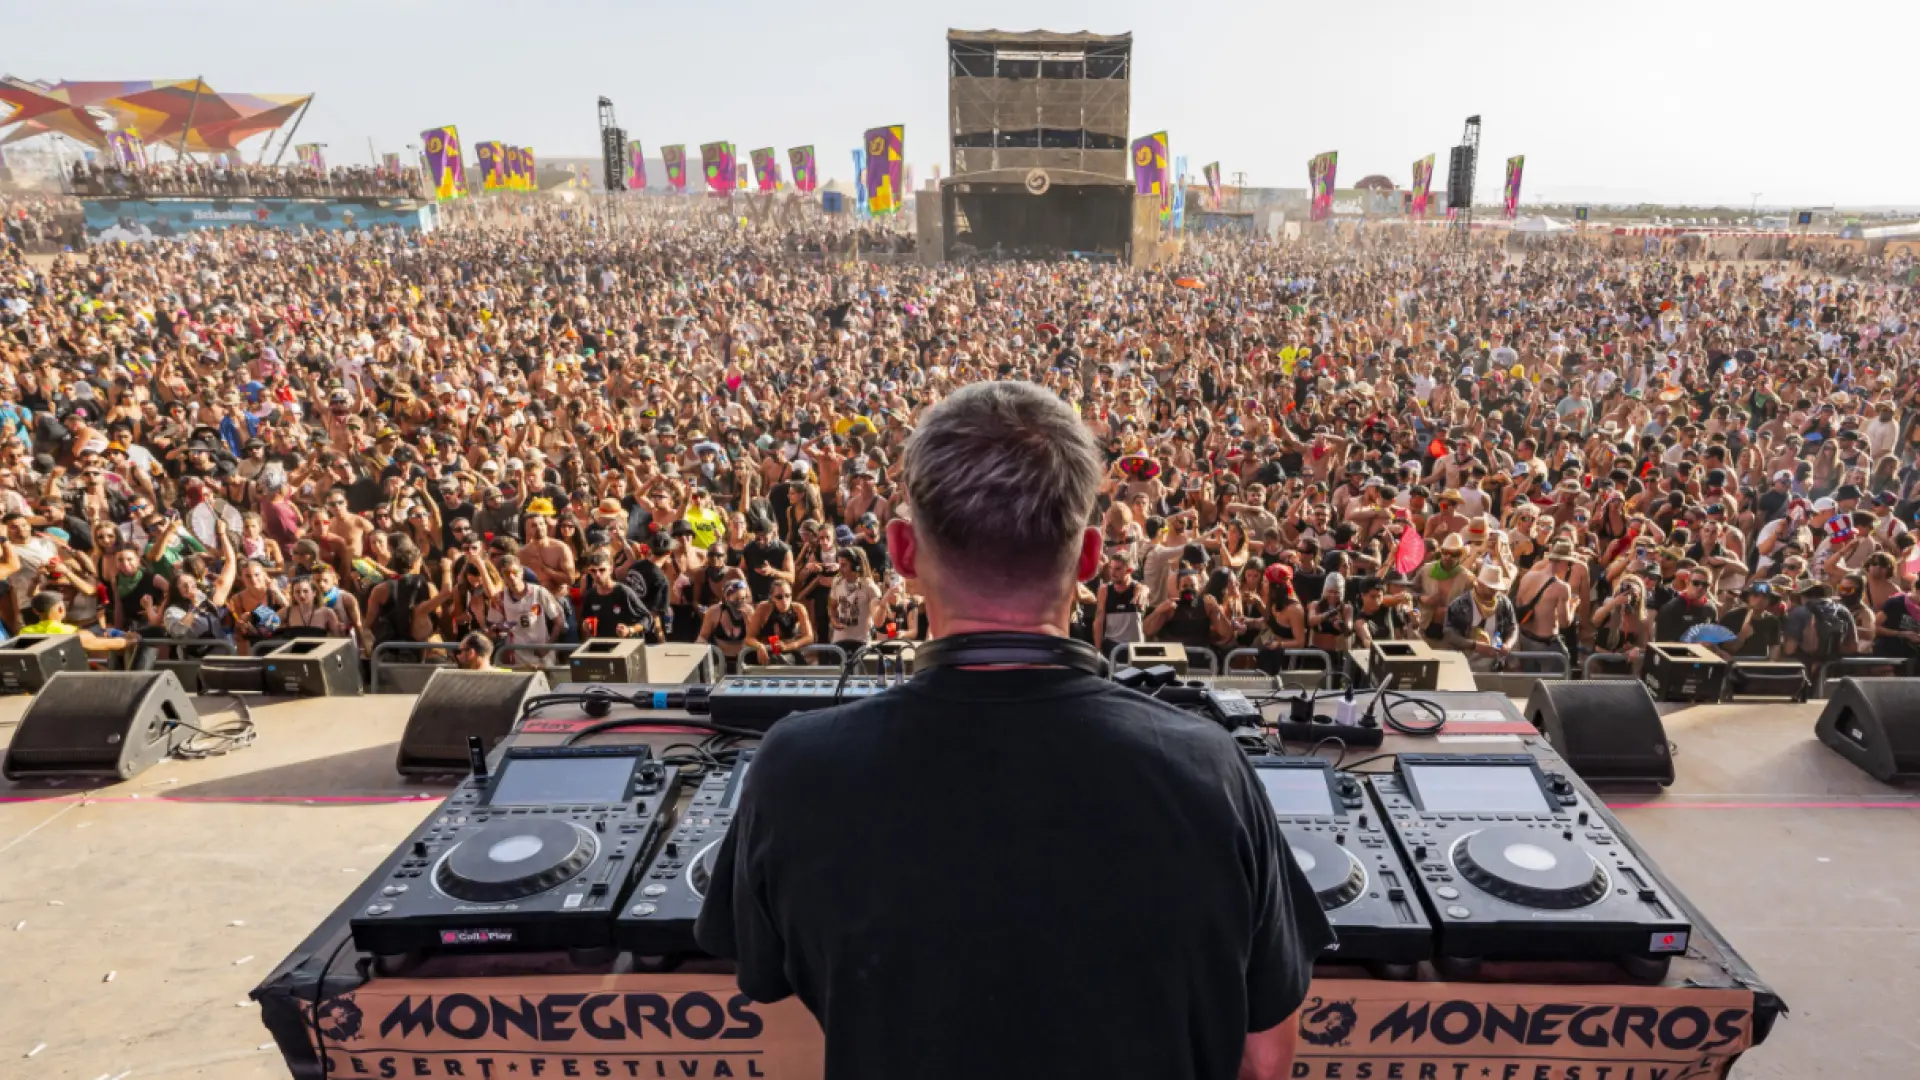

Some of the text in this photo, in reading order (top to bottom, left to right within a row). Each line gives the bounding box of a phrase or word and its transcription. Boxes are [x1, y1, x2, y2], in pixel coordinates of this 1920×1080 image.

[380, 992, 764, 1041] MONEGROS
[1369, 1000, 1749, 1052] MONEGROS
[530, 1058, 765, 1078] FESTIVAL
[1291, 1062, 1469, 1080] DESERT
